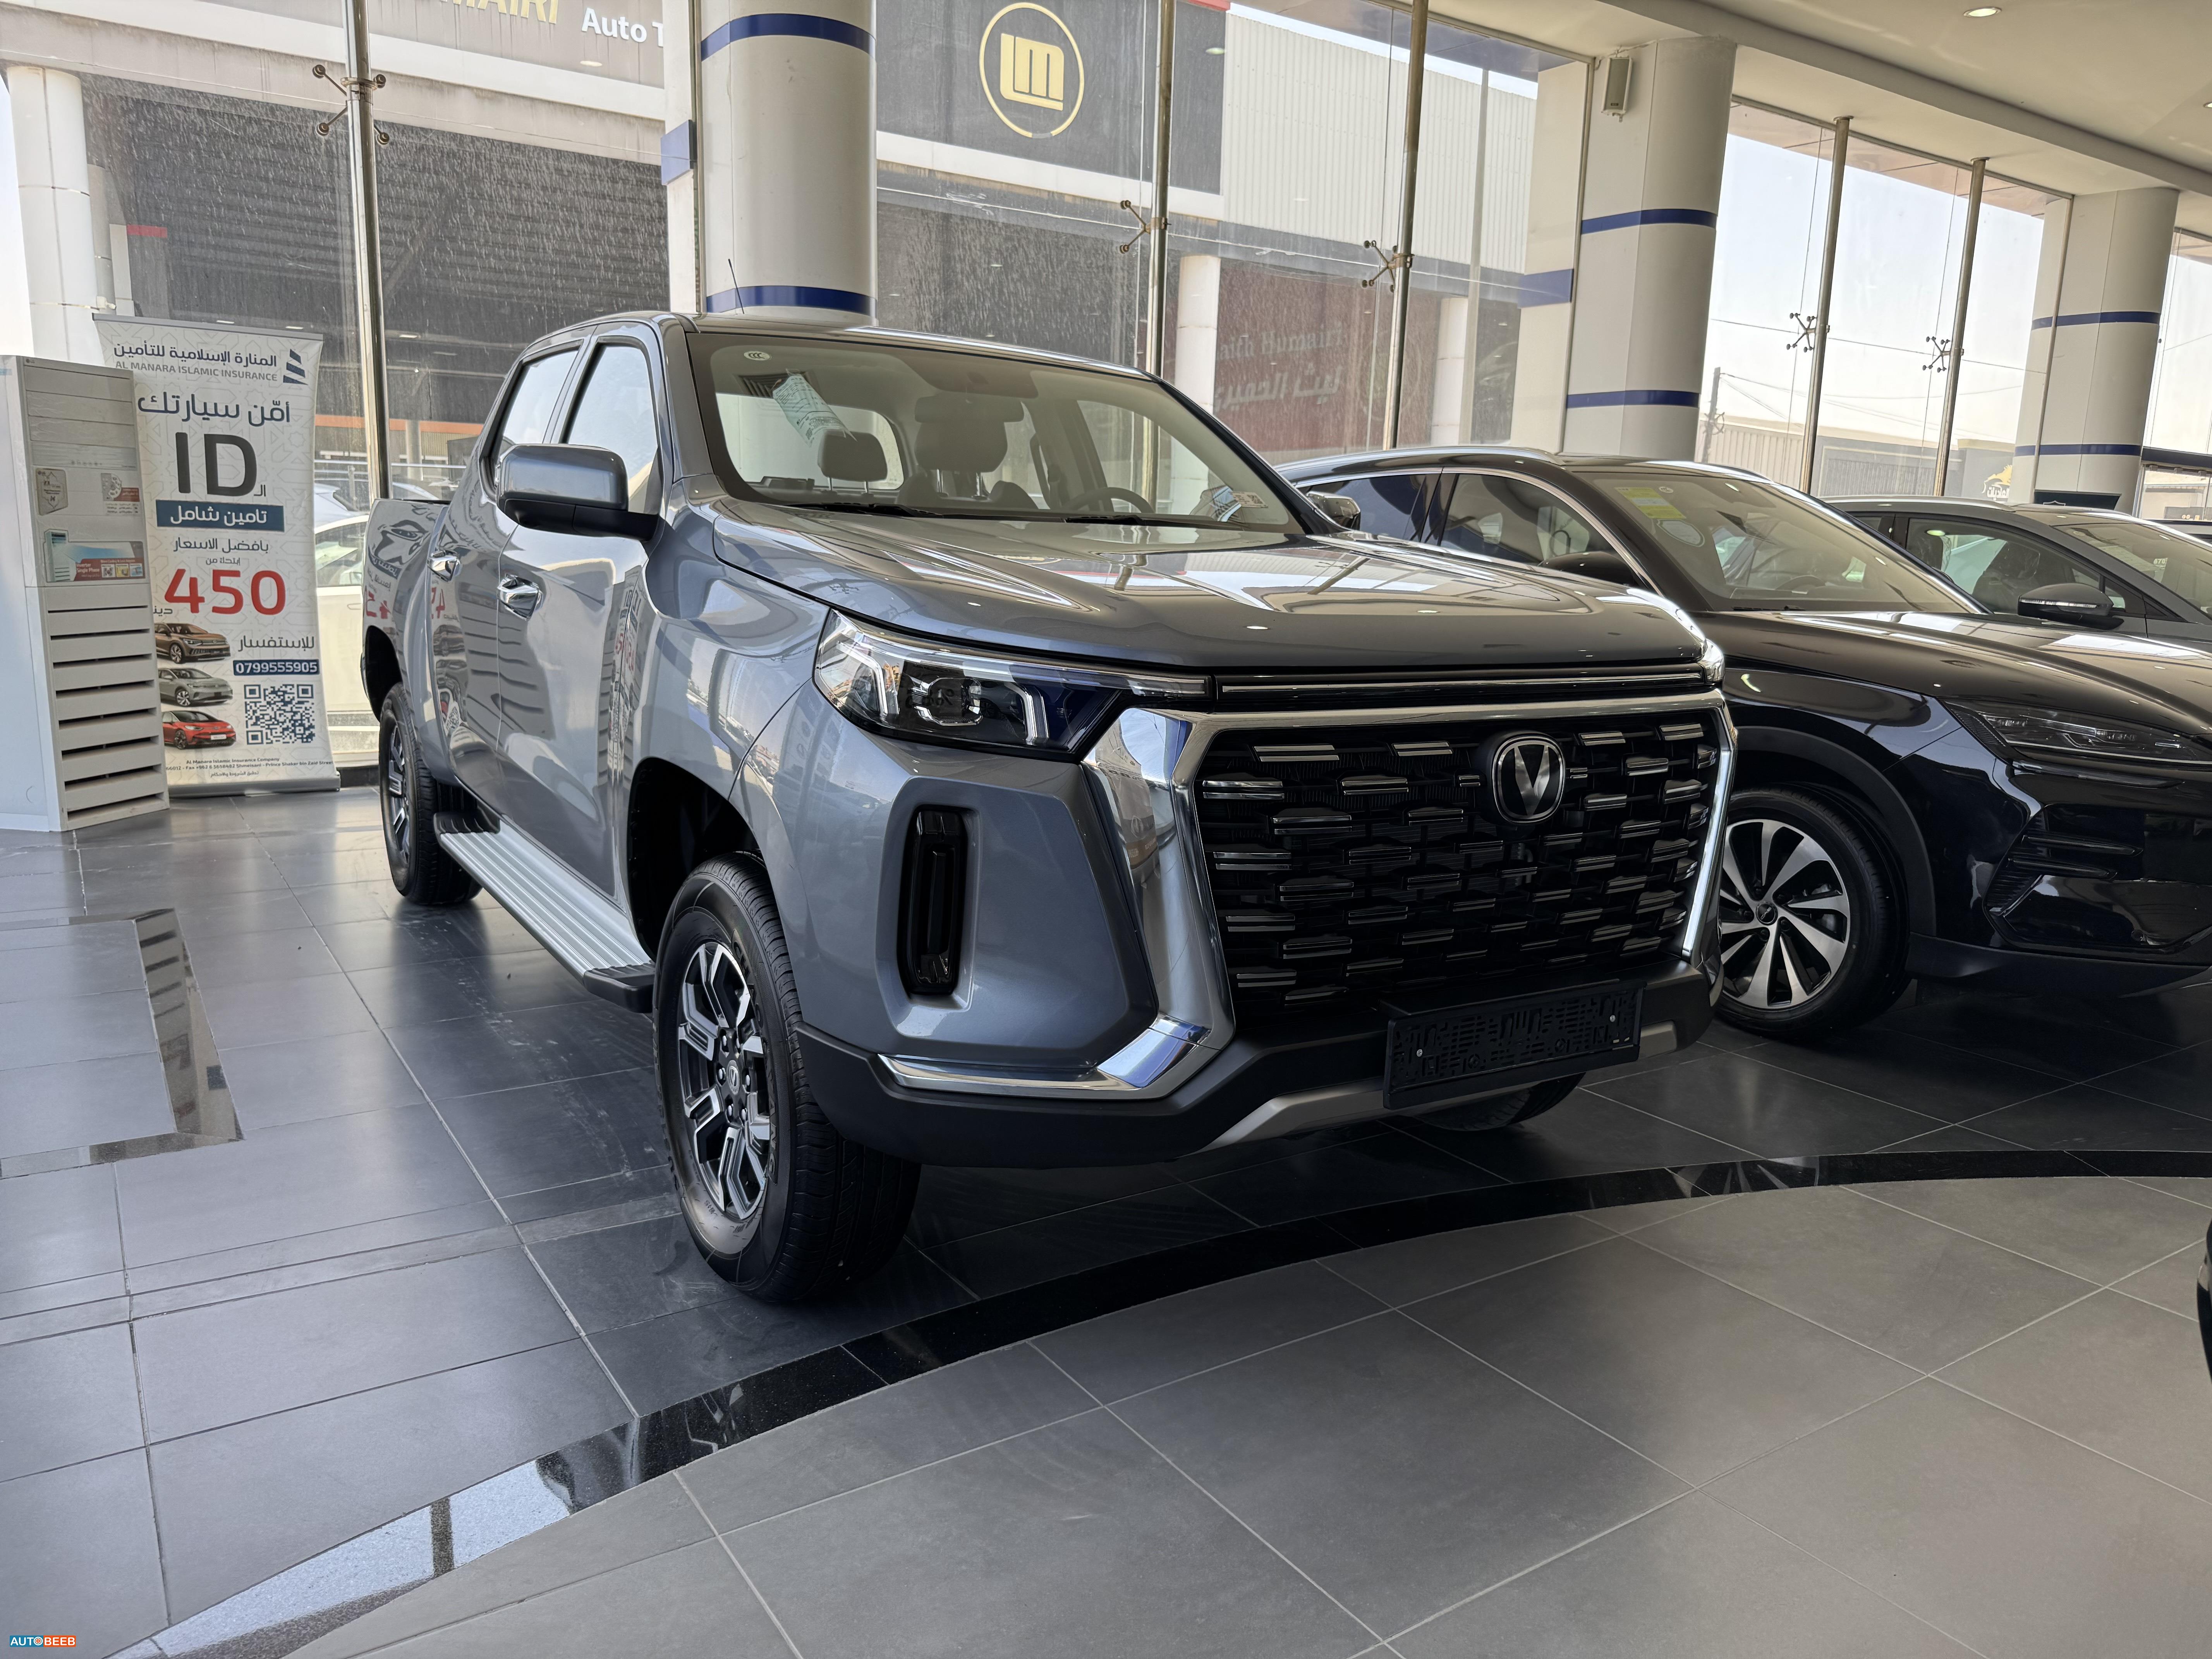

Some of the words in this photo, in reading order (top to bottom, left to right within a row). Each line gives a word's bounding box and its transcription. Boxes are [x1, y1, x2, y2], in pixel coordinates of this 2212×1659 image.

[582, 8, 647, 43] Auto
[114, 340, 165, 358] للتأمين
[170, 347, 230, 366] الإسلامية
[235, 352, 276, 367] المنارة
[131, 362, 176, 373] MANARA
[179, 366, 219, 376] ISLAMIC
[222, 369, 278, 381] INSURANCE
[138, 392, 239, 422] سيارتك
[175, 432, 257, 496] ID
[170, 505, 219, 524] شامل
[224, 509, 267, 526] تامين
[173, 537, 218, 552] الاسعار
[222, 539, 268, 554] بافضل
[164, 568, 286, 615] 450
[153, 606, 173, 617] دين
[238, 635, 314, 652] للإستفسار
[236, 662, 317, 673] 0799555905
